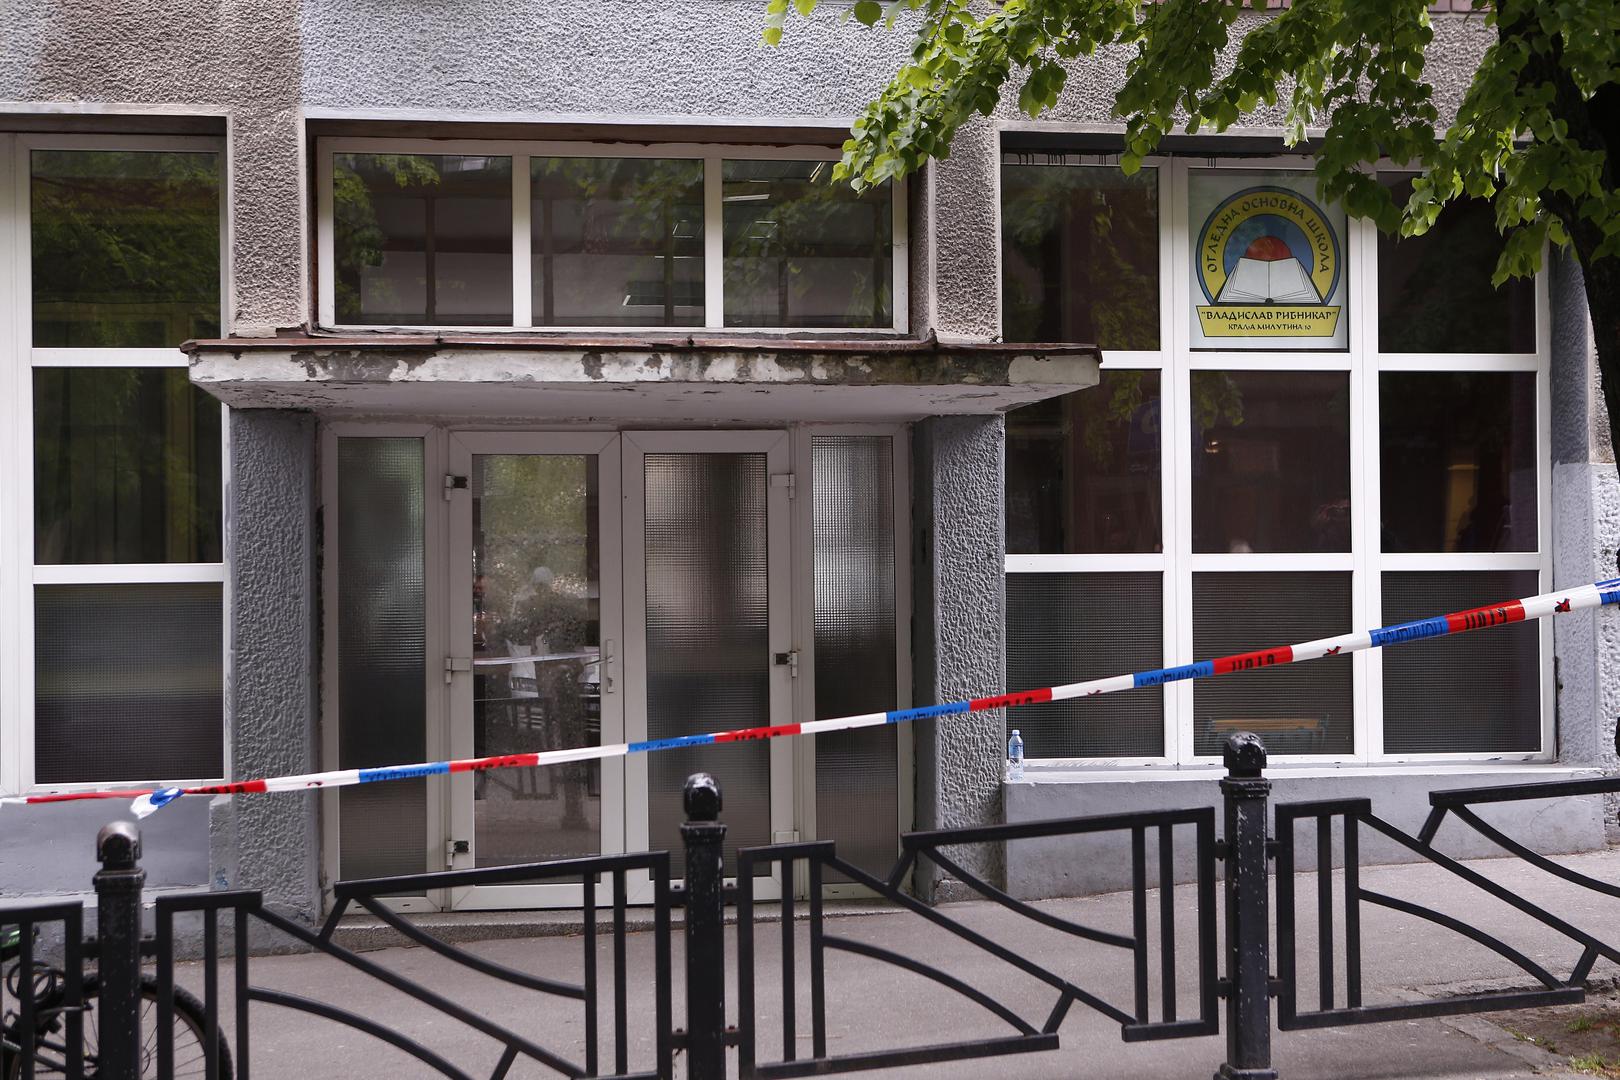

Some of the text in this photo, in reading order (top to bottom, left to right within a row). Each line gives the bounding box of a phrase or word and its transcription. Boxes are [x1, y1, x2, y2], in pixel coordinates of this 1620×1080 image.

[1206, 198, 1330, 273] ОГЛЕДНА ОСНОВНА ШКОЛА
[1201, 311, 1337, 321] "ВЛАДИСЛАВ РИБНИКАР"
